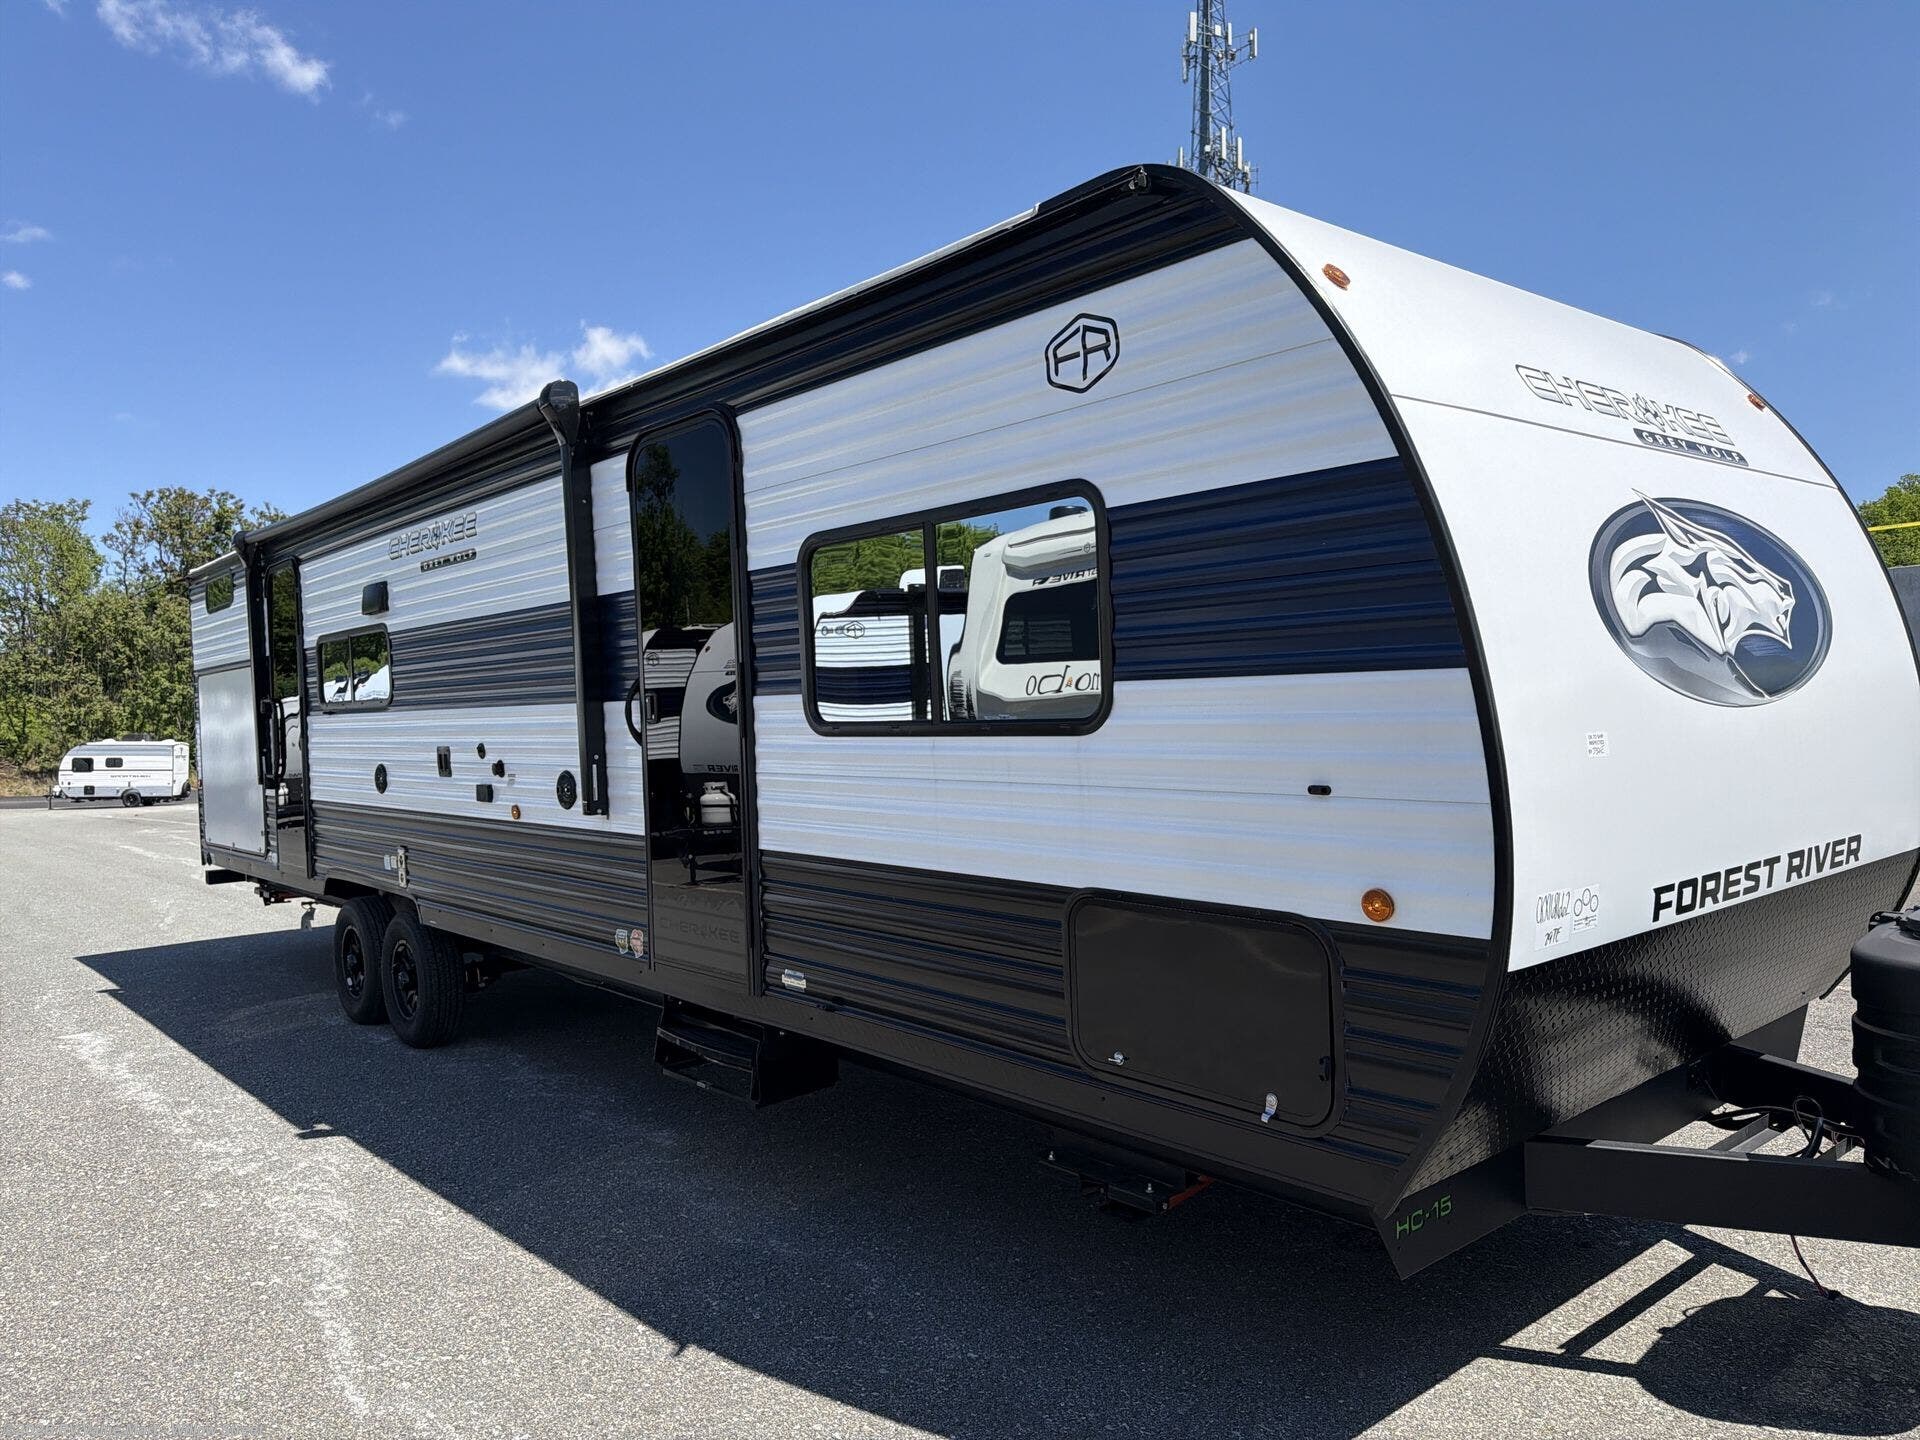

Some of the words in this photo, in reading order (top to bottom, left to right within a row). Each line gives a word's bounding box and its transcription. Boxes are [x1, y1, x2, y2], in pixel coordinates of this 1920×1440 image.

[1515, 364, 1735, 446] CHEROKEE
[1642, 431, 1688, 452] GREY
[1697, 445, 1741, 463] WOLF
[1652, 854, 1781, 922] FOREST
[1786, 834, 1862, 883] RIVER
